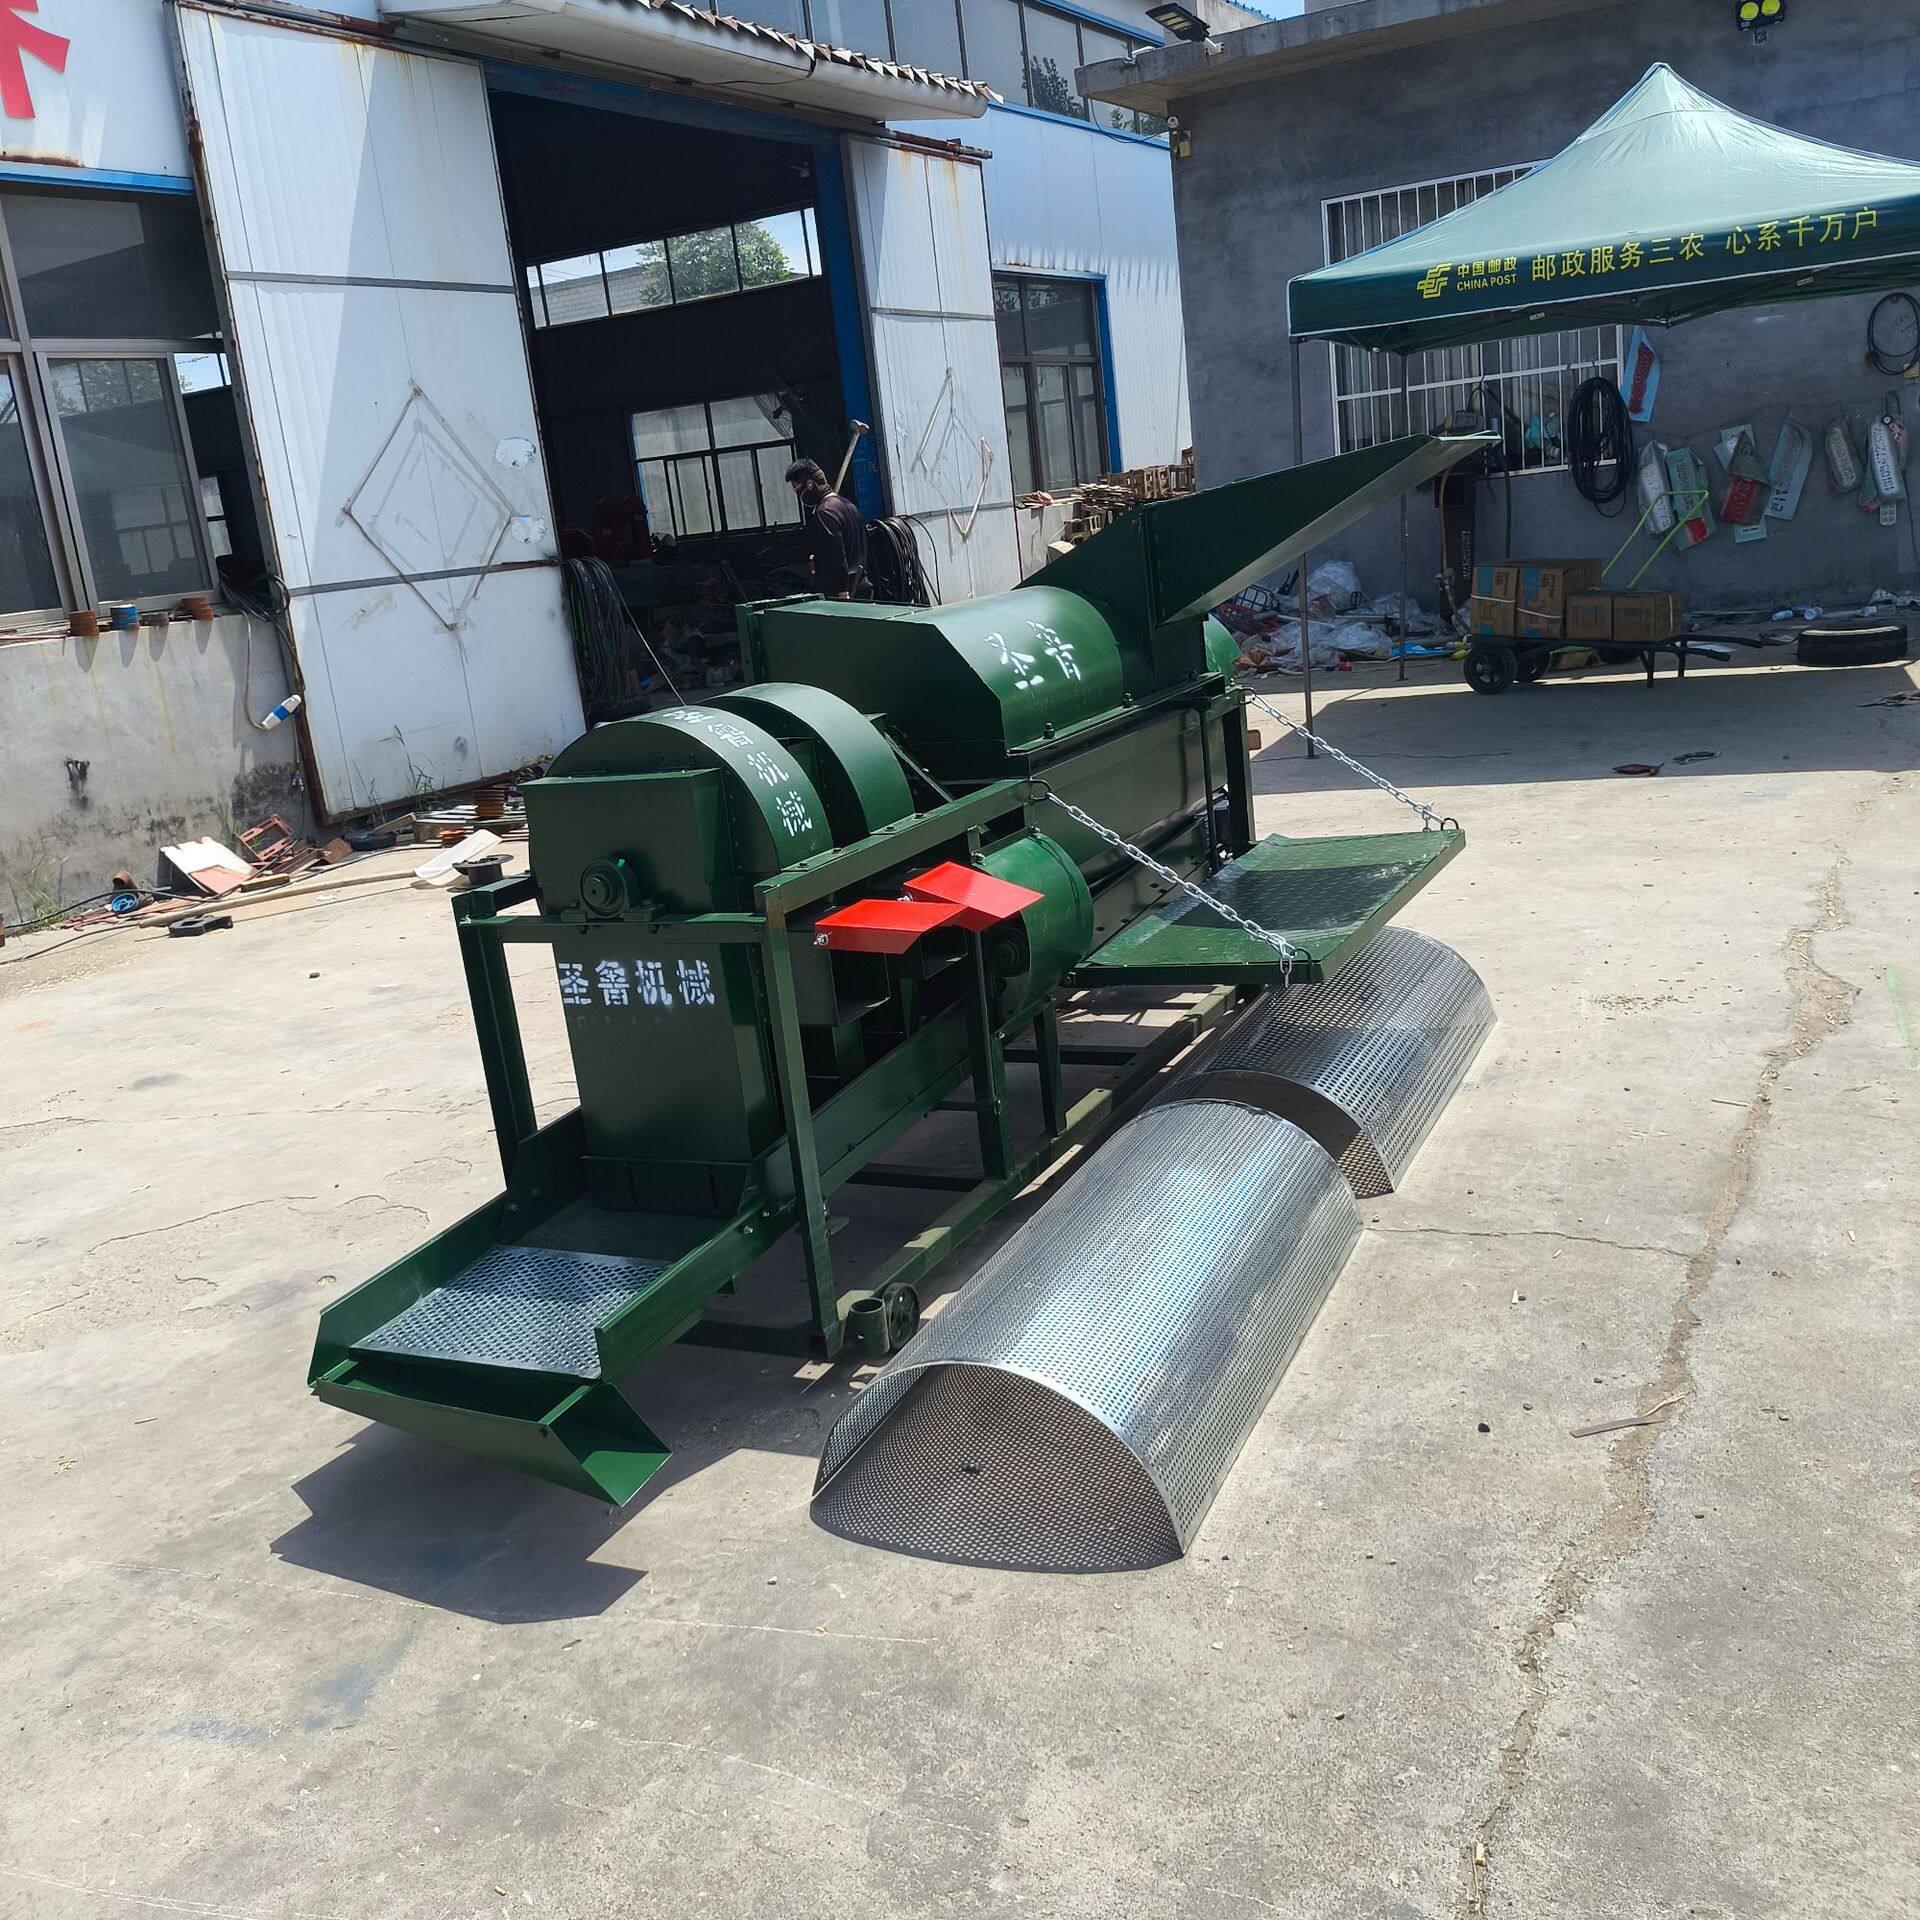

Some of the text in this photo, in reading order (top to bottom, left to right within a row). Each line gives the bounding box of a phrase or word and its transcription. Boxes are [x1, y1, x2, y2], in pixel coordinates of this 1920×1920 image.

[1531, 206, 1877, 281] 邮政服务三农 心系千万户
[1456, 273, 1517, 291] CHINA POST
[1457, 256, 1517, 278] 中国邮政
[558, 959, 715, 1006] 圣鲁机械
